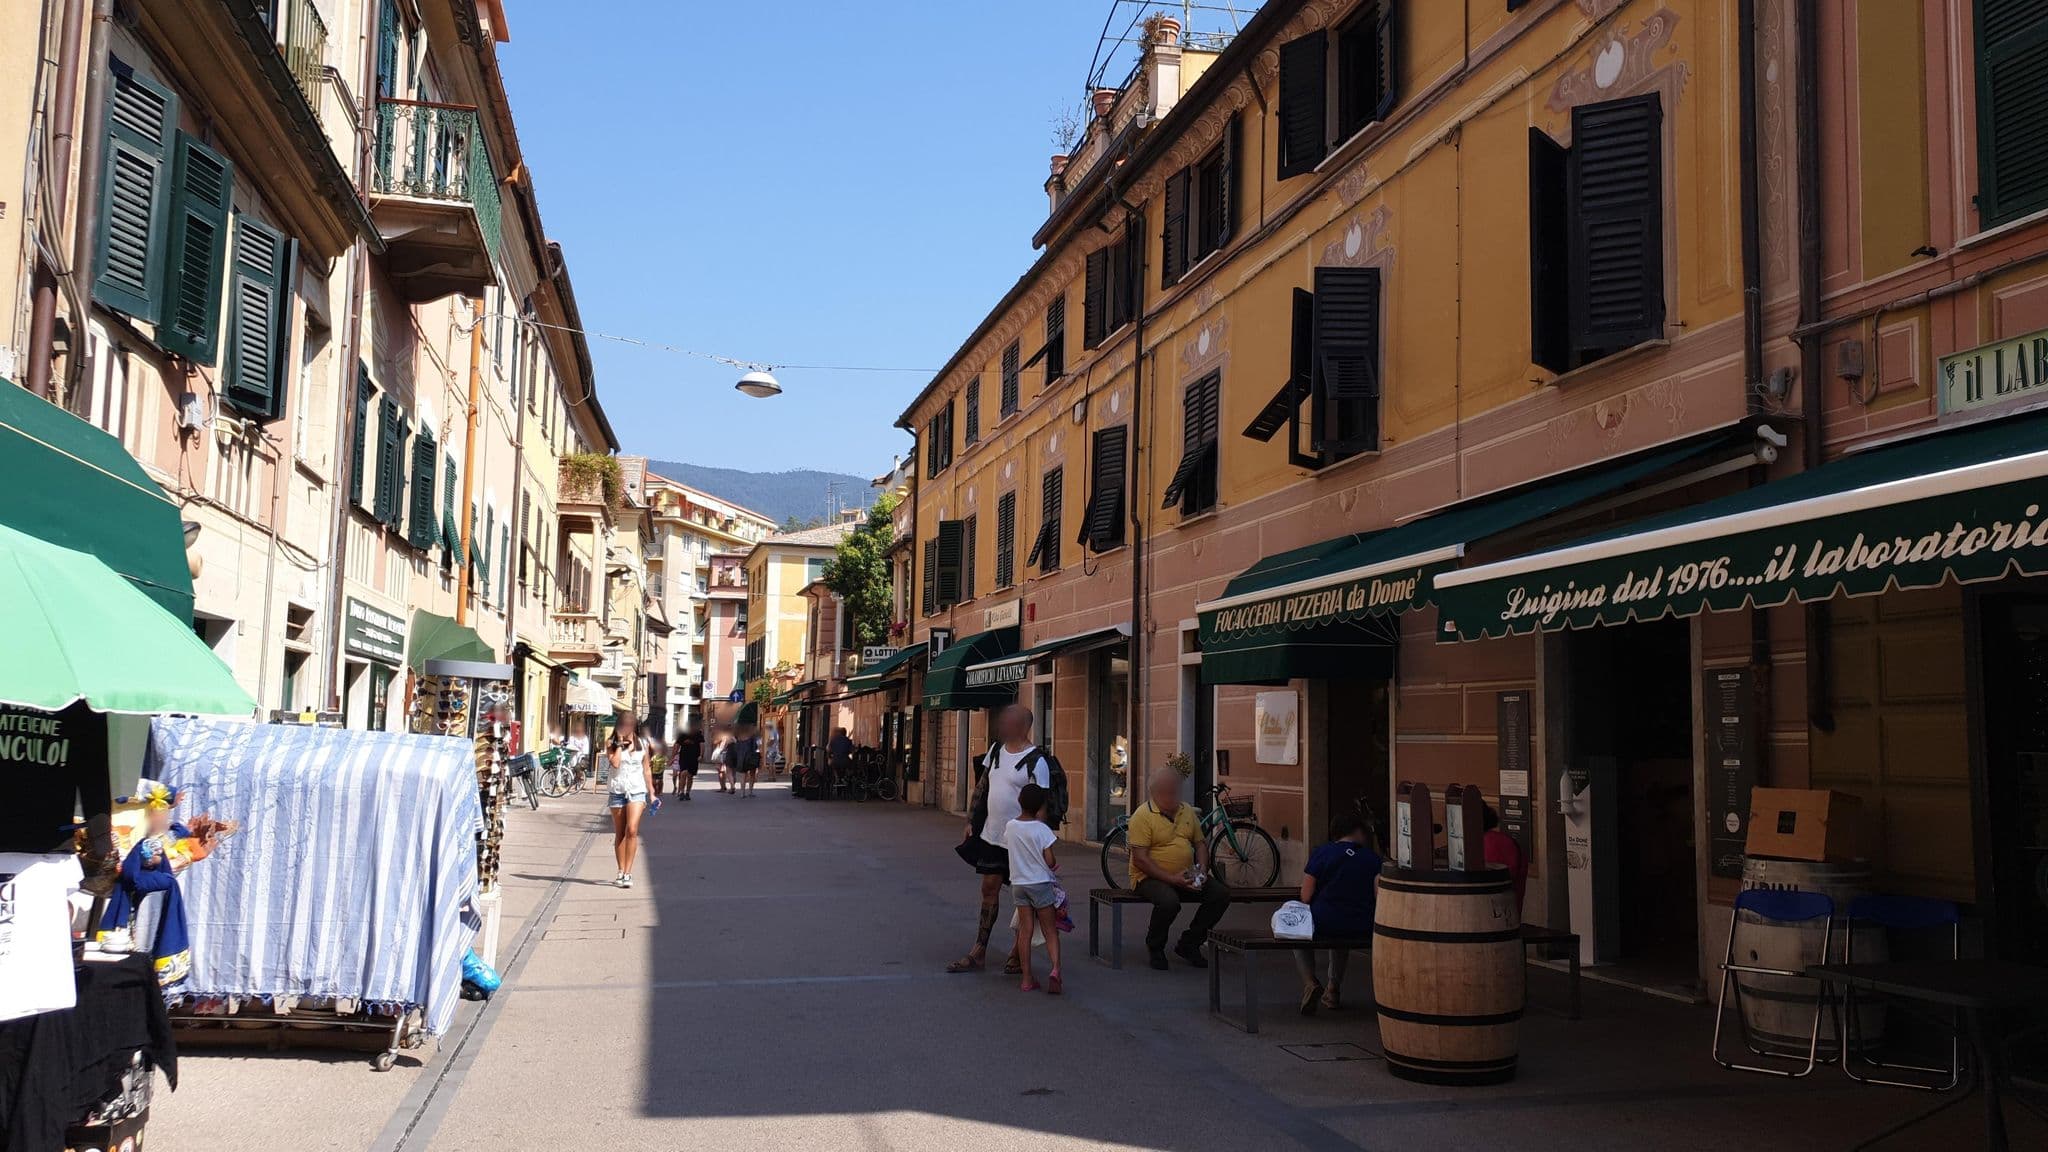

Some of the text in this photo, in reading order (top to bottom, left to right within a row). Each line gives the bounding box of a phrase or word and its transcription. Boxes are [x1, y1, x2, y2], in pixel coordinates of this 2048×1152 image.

[1964, 355, 1983, 403] il
[1214, 604, 1281, 633] FOCACCERIA
[1283, 587, 1344, 623] PIZZERIA
[1346, 583, 1366, 612] da
[1501, 581, 1607, 624] Luigina
[1612, 566, 1664, 605] dal
[875, 648, 898, 657] LOTTO
